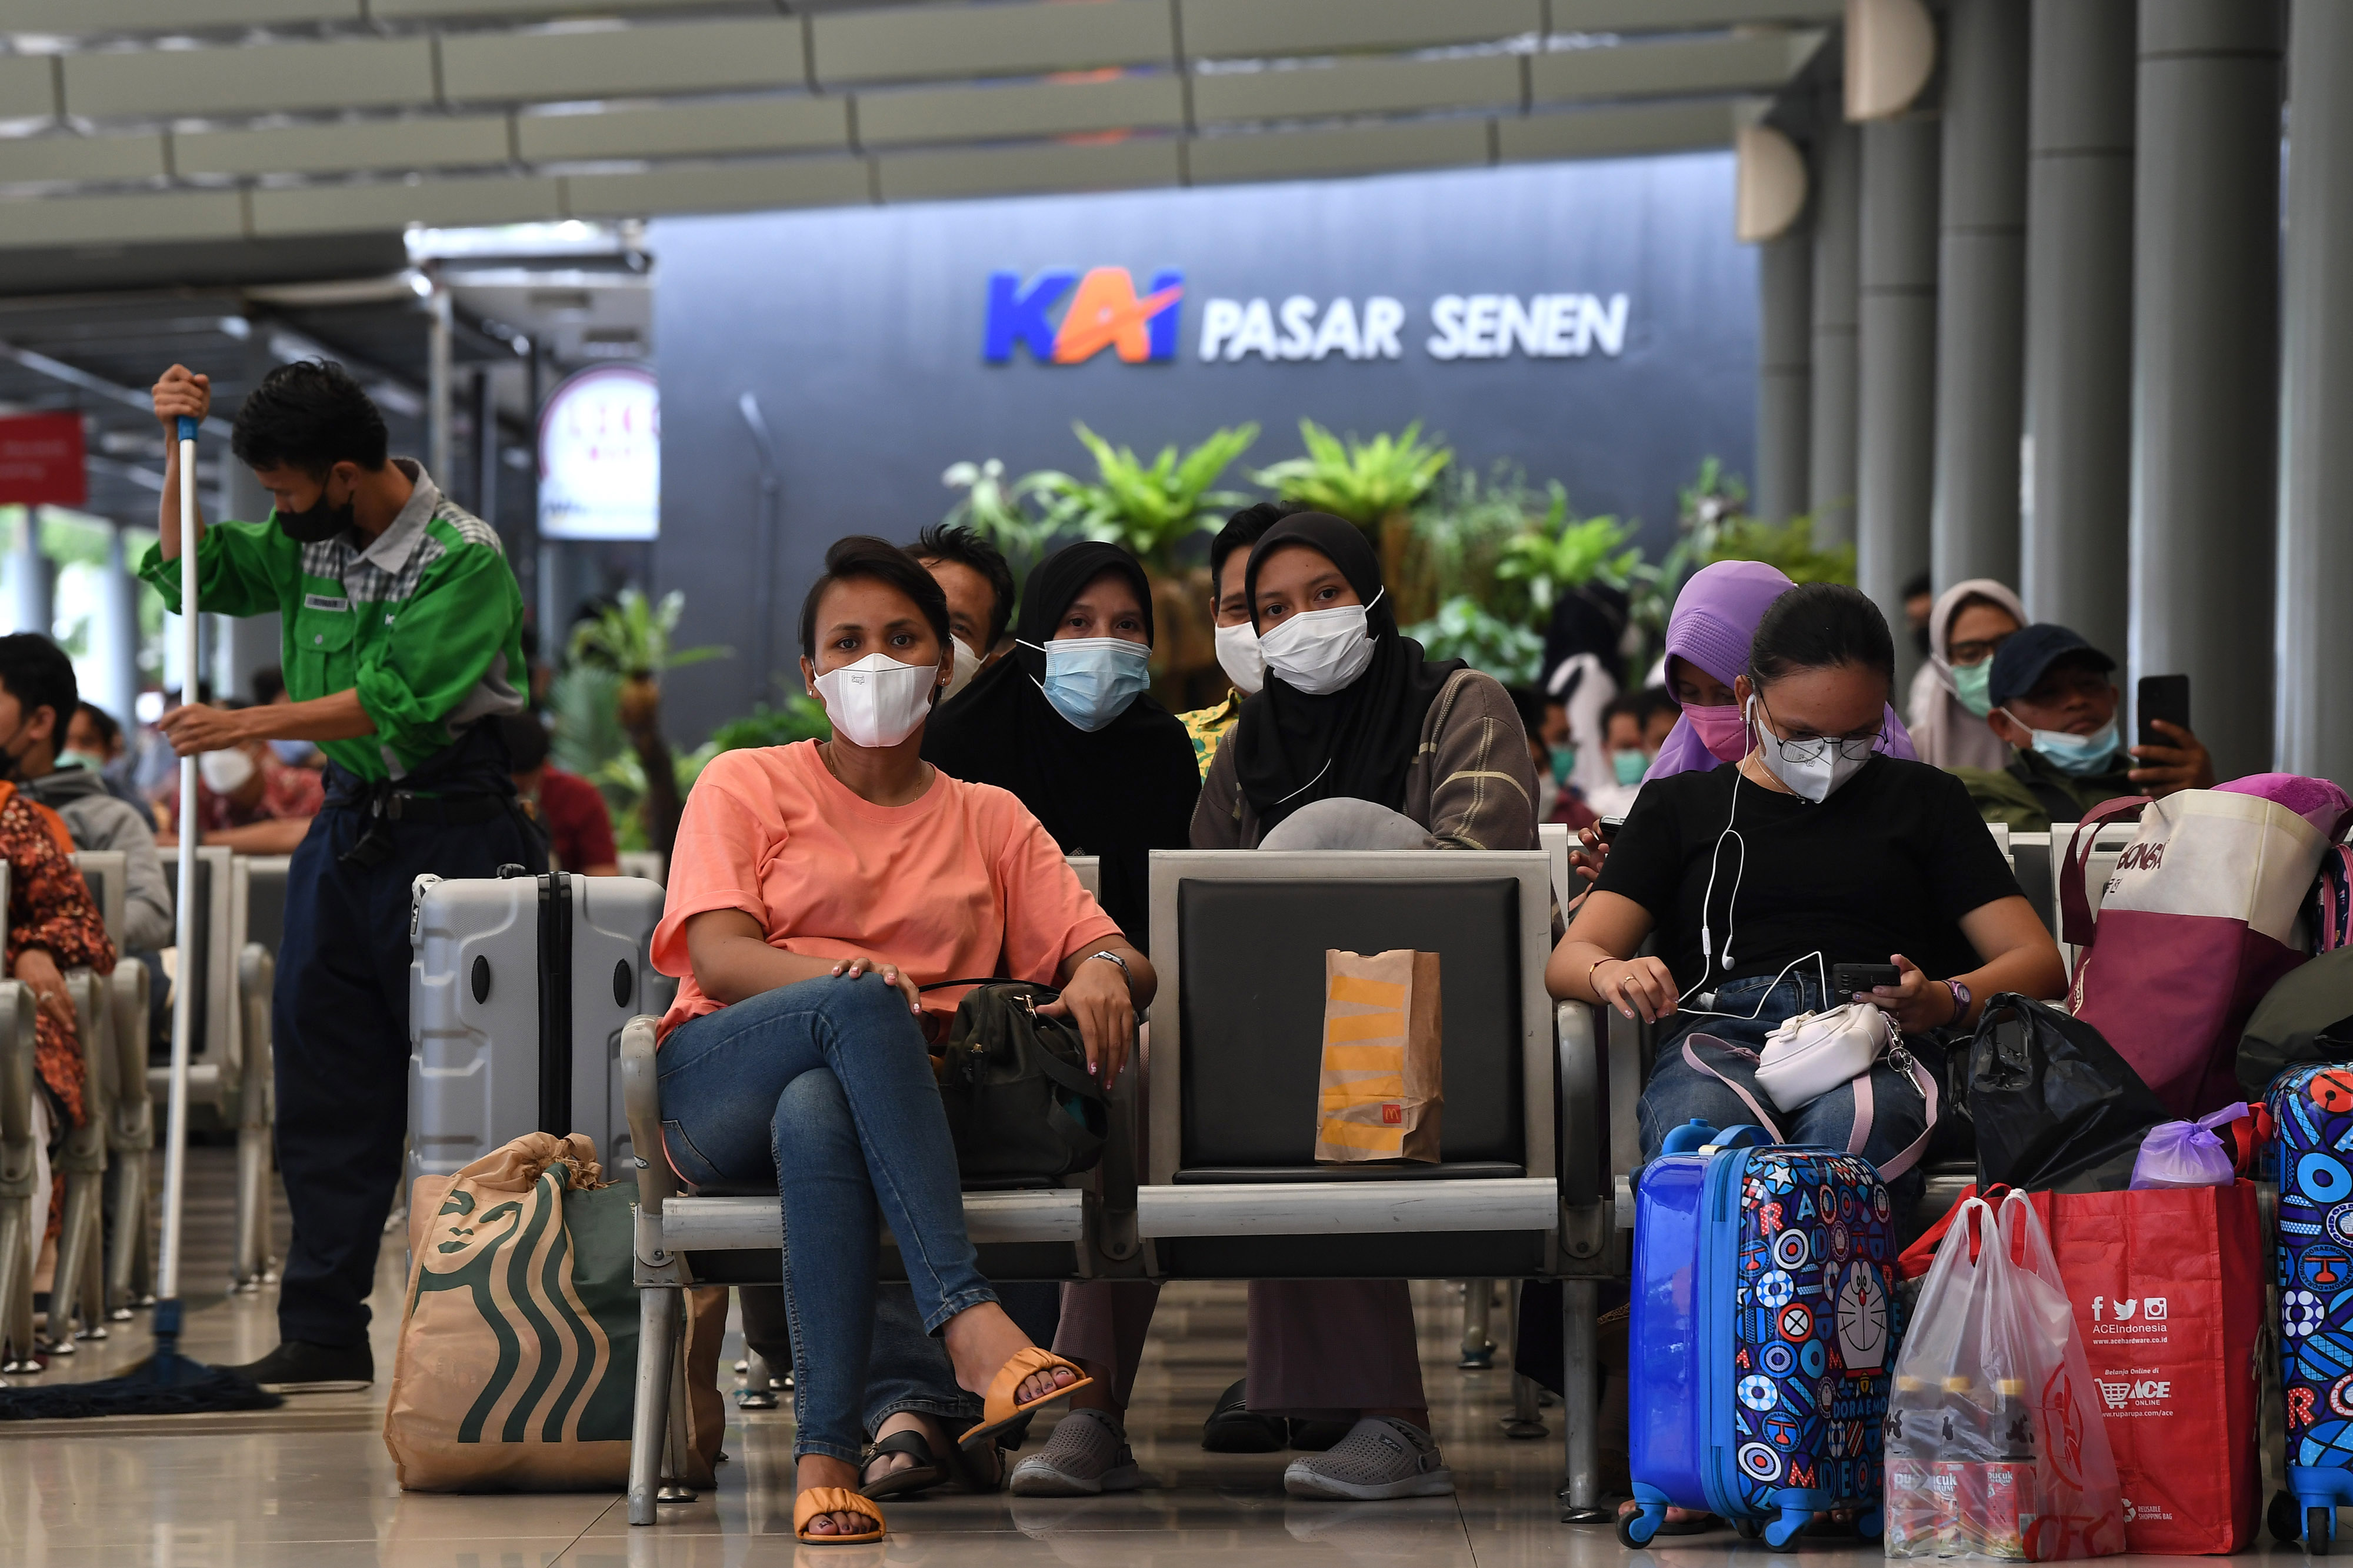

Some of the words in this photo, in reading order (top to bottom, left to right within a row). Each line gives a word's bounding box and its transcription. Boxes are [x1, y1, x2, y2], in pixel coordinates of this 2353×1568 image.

[984, 266, 1184, 363] KAI
[1198, 296, 1405, 360] PASAR
[1427, 292, 1629, 359] SENEN
[2092, 1323, 2167, 1334] ACEIndonesia
[2128, 1379, 2170, 1399] ACE
[1833, 1396, 1887, 1419] DORAEMO
[2102, 1410, 2174, 1418] ww.ruparupa.com/ace
